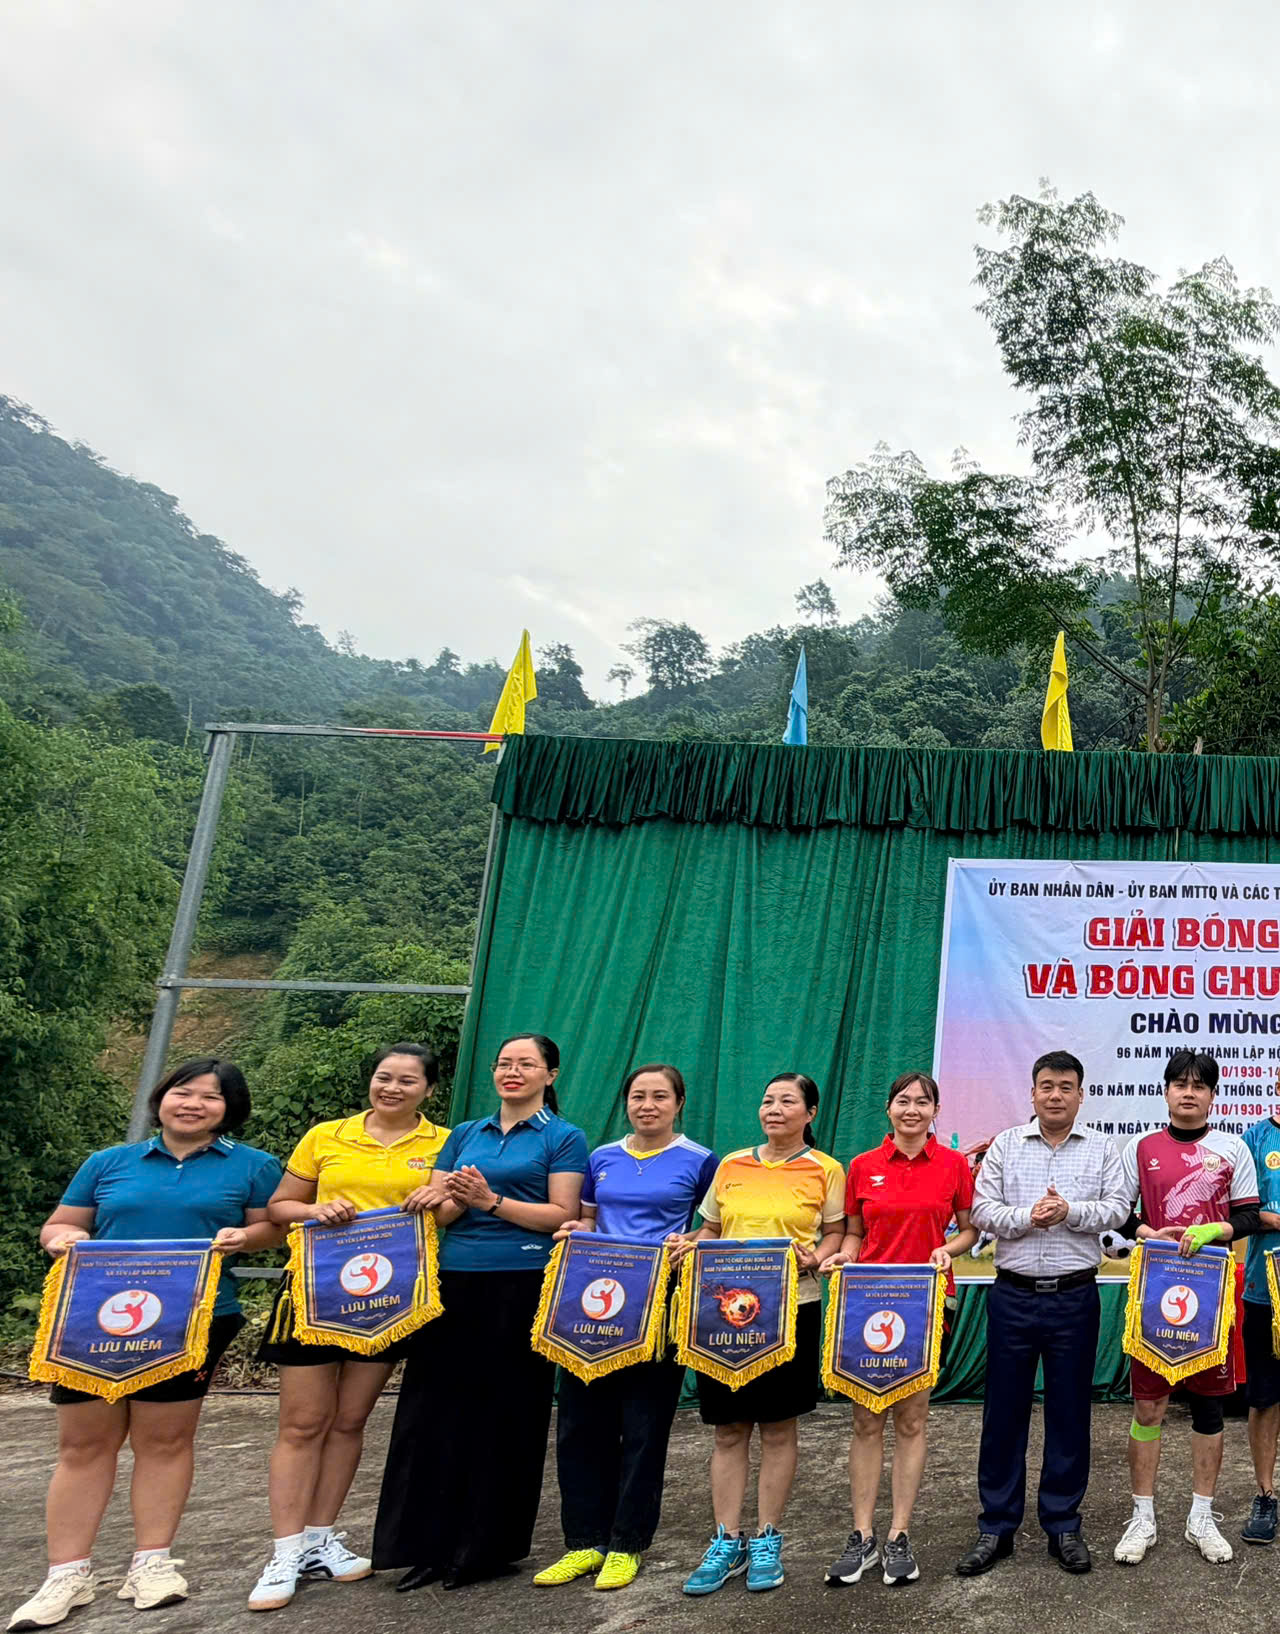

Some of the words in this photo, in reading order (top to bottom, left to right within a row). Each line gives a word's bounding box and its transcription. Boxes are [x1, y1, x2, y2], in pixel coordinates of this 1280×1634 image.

[988, 878, 1007, 897] ỦY
[1011, 883, 1038, 897] BAN
[1043, 881, 1081, 898] NHÂN
[1086, 881, 1114, 898] DÂN
[1128, 880, 1145, 899] ỦY
[1150, 884, 1177, 899] BAN
[1182, 885, 1218, 900] MTTQ
[1222, 884, 1239, 900] VÀ
[1243, 883, 1269, 900] CÁC
[1086, 909, 1165, 949] GIẢI
[1175, 912, 1280, 950] BÓNG
[1026, 957, 1078, 997] VÀ
[1087, 958, 1195, 998] BÓNG
[1131, 1009, 1199, 1034] CHÀO
[1117, 1047, 1131, 1058] 96
[1135, 1045, 1161, 1059] NĂM
[1243, 1046, 1264, 1061] LẬP
[1089, 1085, 1103, 1096] 96
[1107, 1082, 1134, 1096] NĂM
[1139, 1082, 1163, 1096] NGÀ
[1223, 1080, 1262, 1097] THỐNG
[1118, 1120, 1150, 1134] NGÀY
[340, 1301, 366, 1315] LƯU
[369, 1295, 401, 1310] NIỆM
[573, 1324, 595, 1335] LƯU
[597, 1323, 624, 1338] NIỆM
[709, 1332, 732, 1346] LƯU
[736, 1330, 766, 1347] NIỆM
[1156, 1327, 1174, 1339] LƯU
[1176, 1330, 1200, 1343] NIỆM
[89, 1340, 121, 1354] LƯU
[124, 1338, 162, 1354] NIỆM
[860, 1357, 880, 1368] LƯU
[882, 1356, 908, 1370] NIỆM
